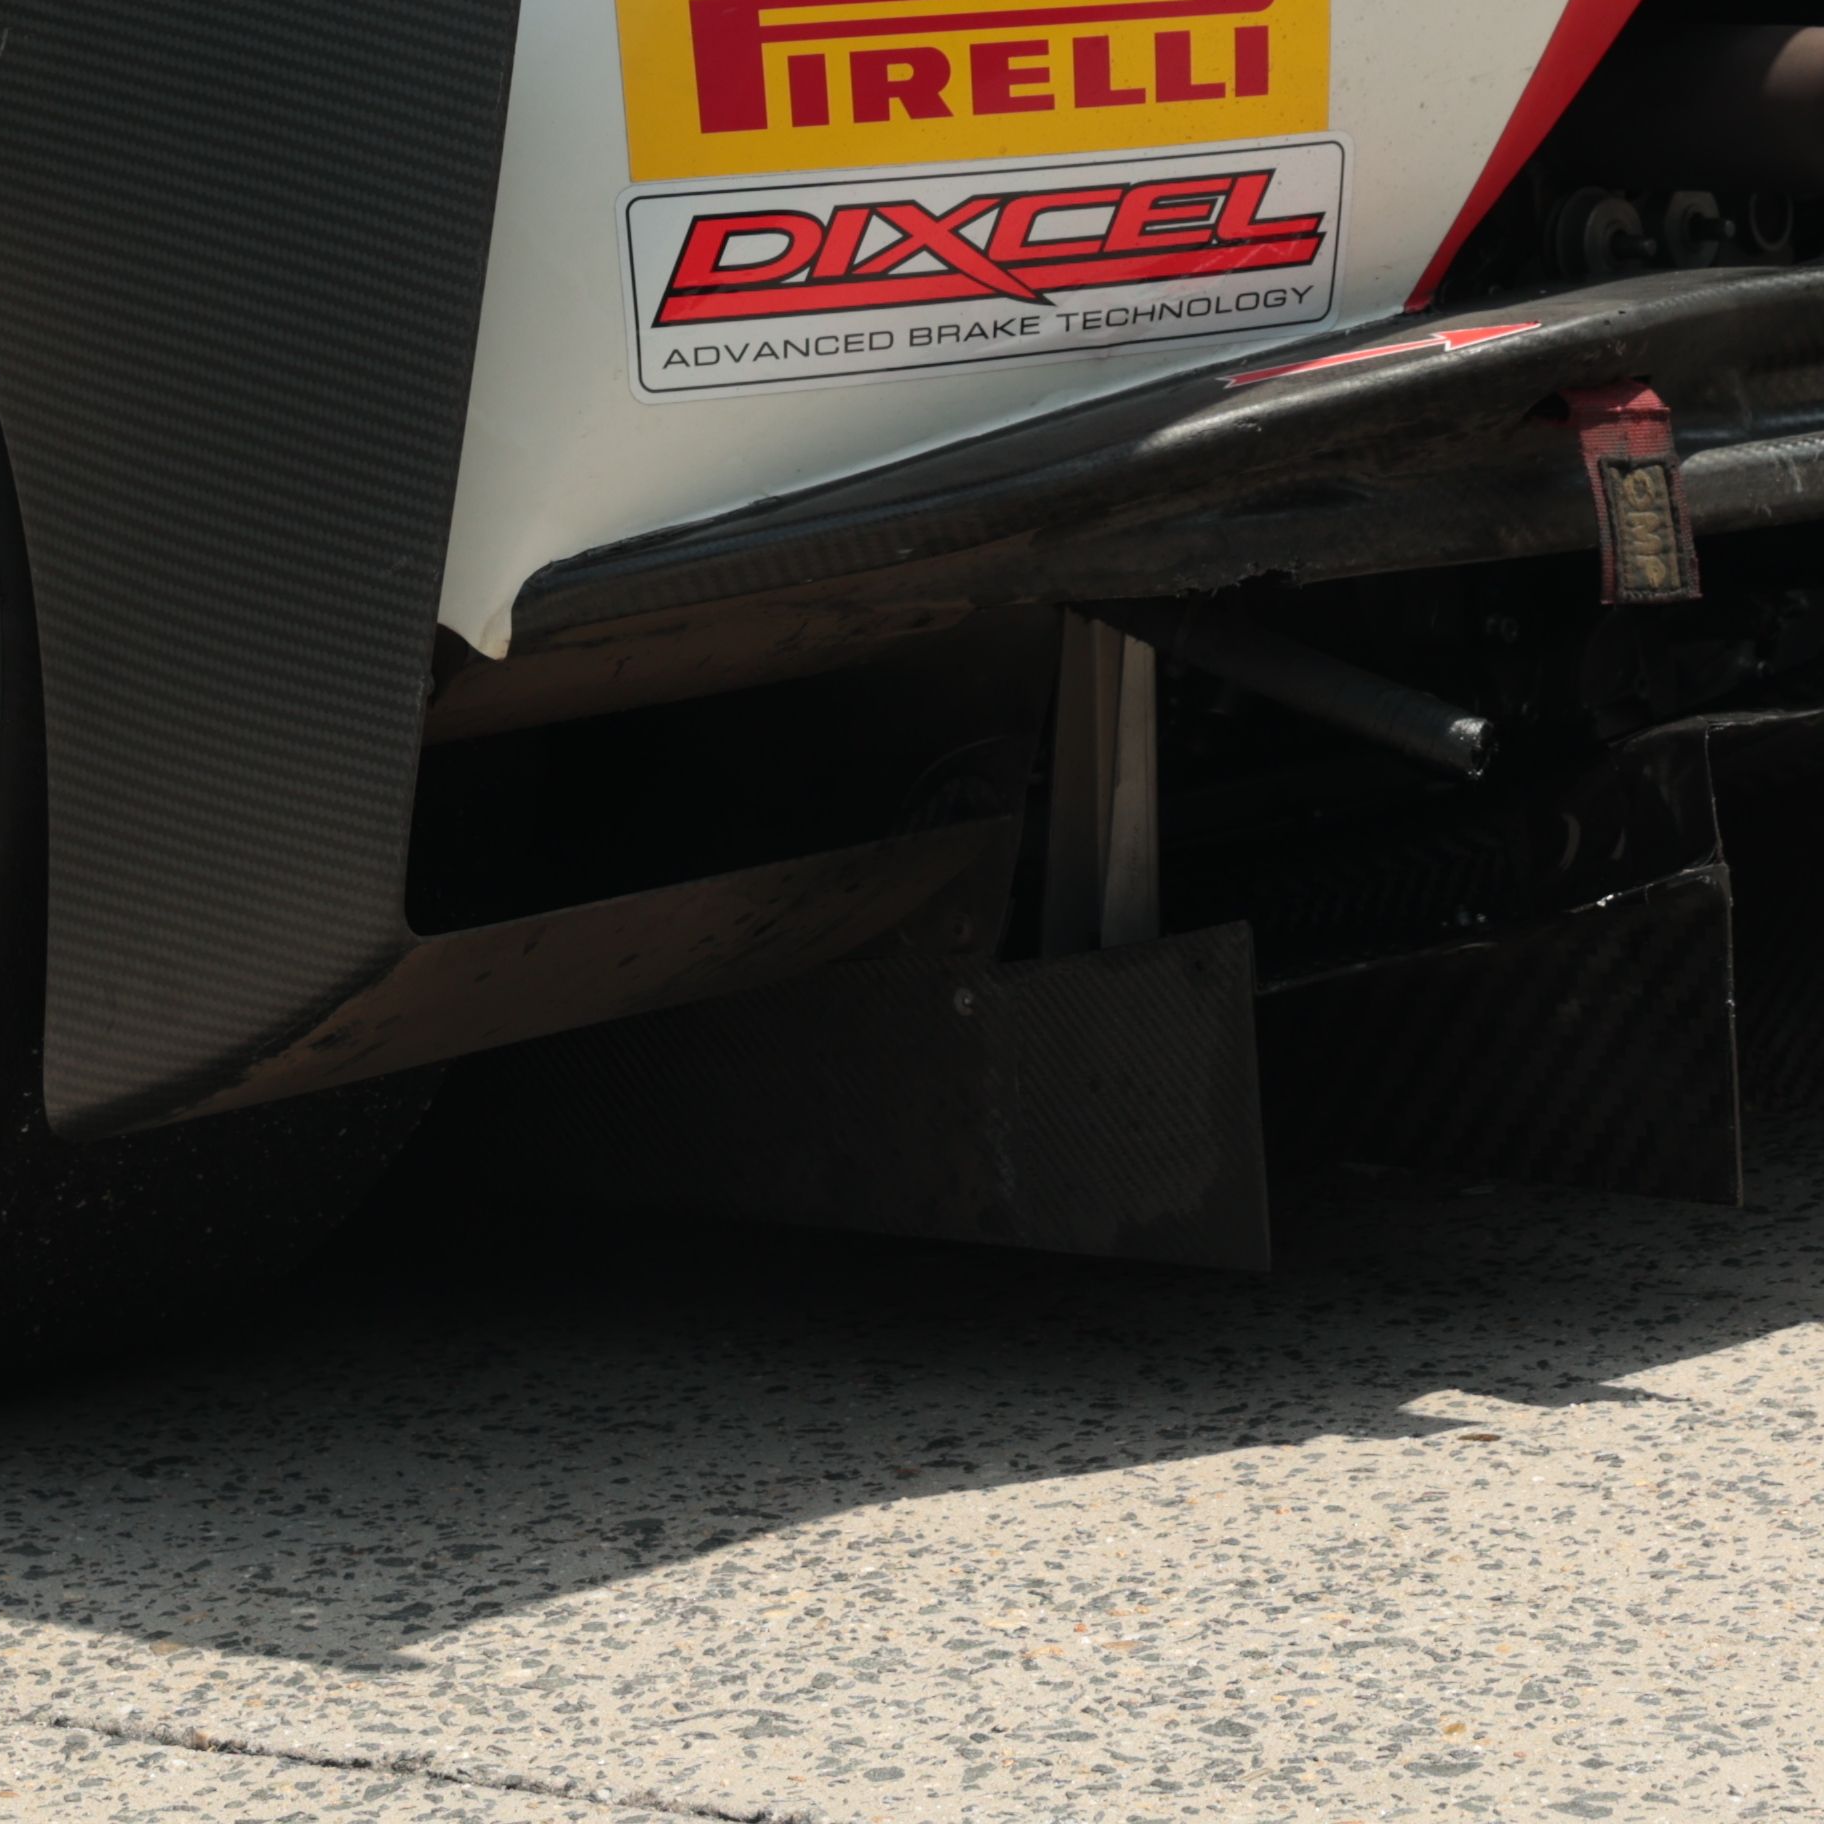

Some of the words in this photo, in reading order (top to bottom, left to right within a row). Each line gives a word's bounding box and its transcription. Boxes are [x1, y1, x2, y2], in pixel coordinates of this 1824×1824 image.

[652, 168, 1326, 326] DIXCEL
[662, 329, 896, 370] ADVANCED
[908, 314, 1041, 348] BRAKE
[1055, 284, 1317, 334] TECHNOLOGY
